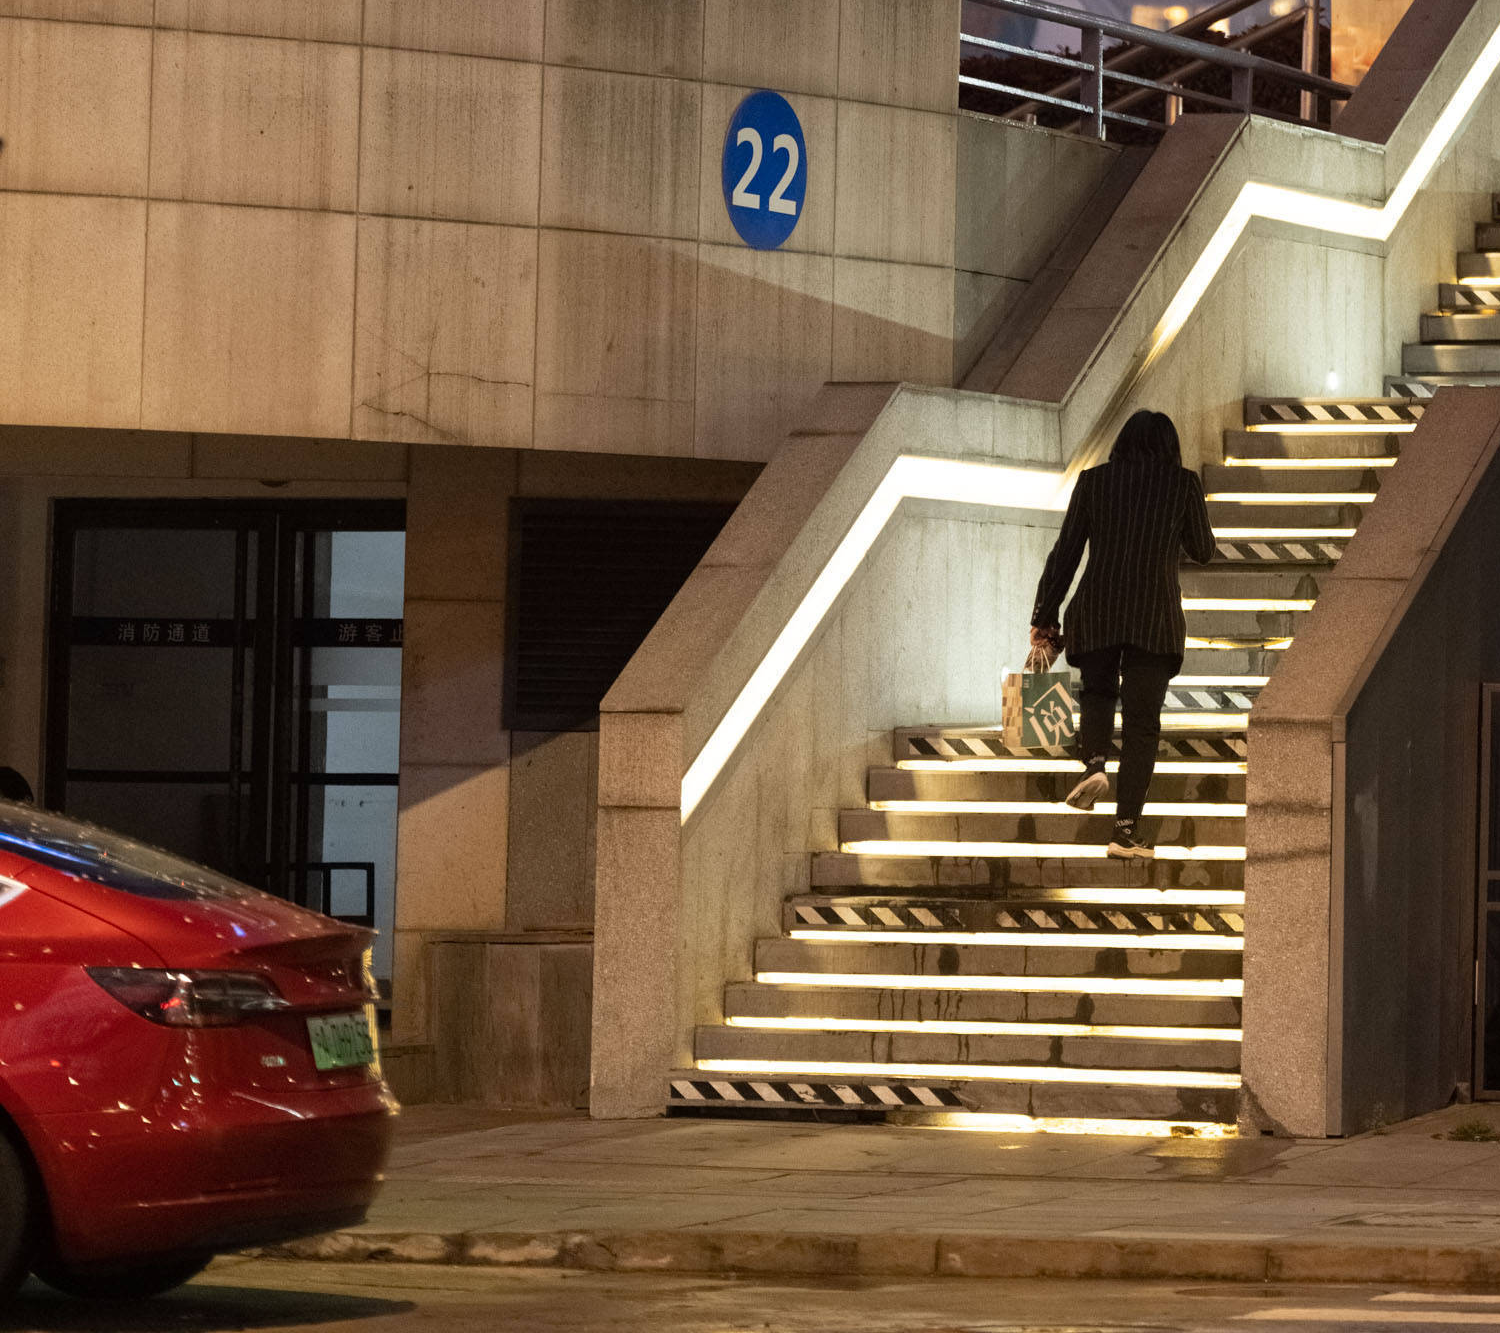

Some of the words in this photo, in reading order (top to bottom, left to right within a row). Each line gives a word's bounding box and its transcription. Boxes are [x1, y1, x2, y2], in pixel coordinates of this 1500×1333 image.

[731, 127, 800, 216] 22
[117, 622, 211, 643] 消防通道
